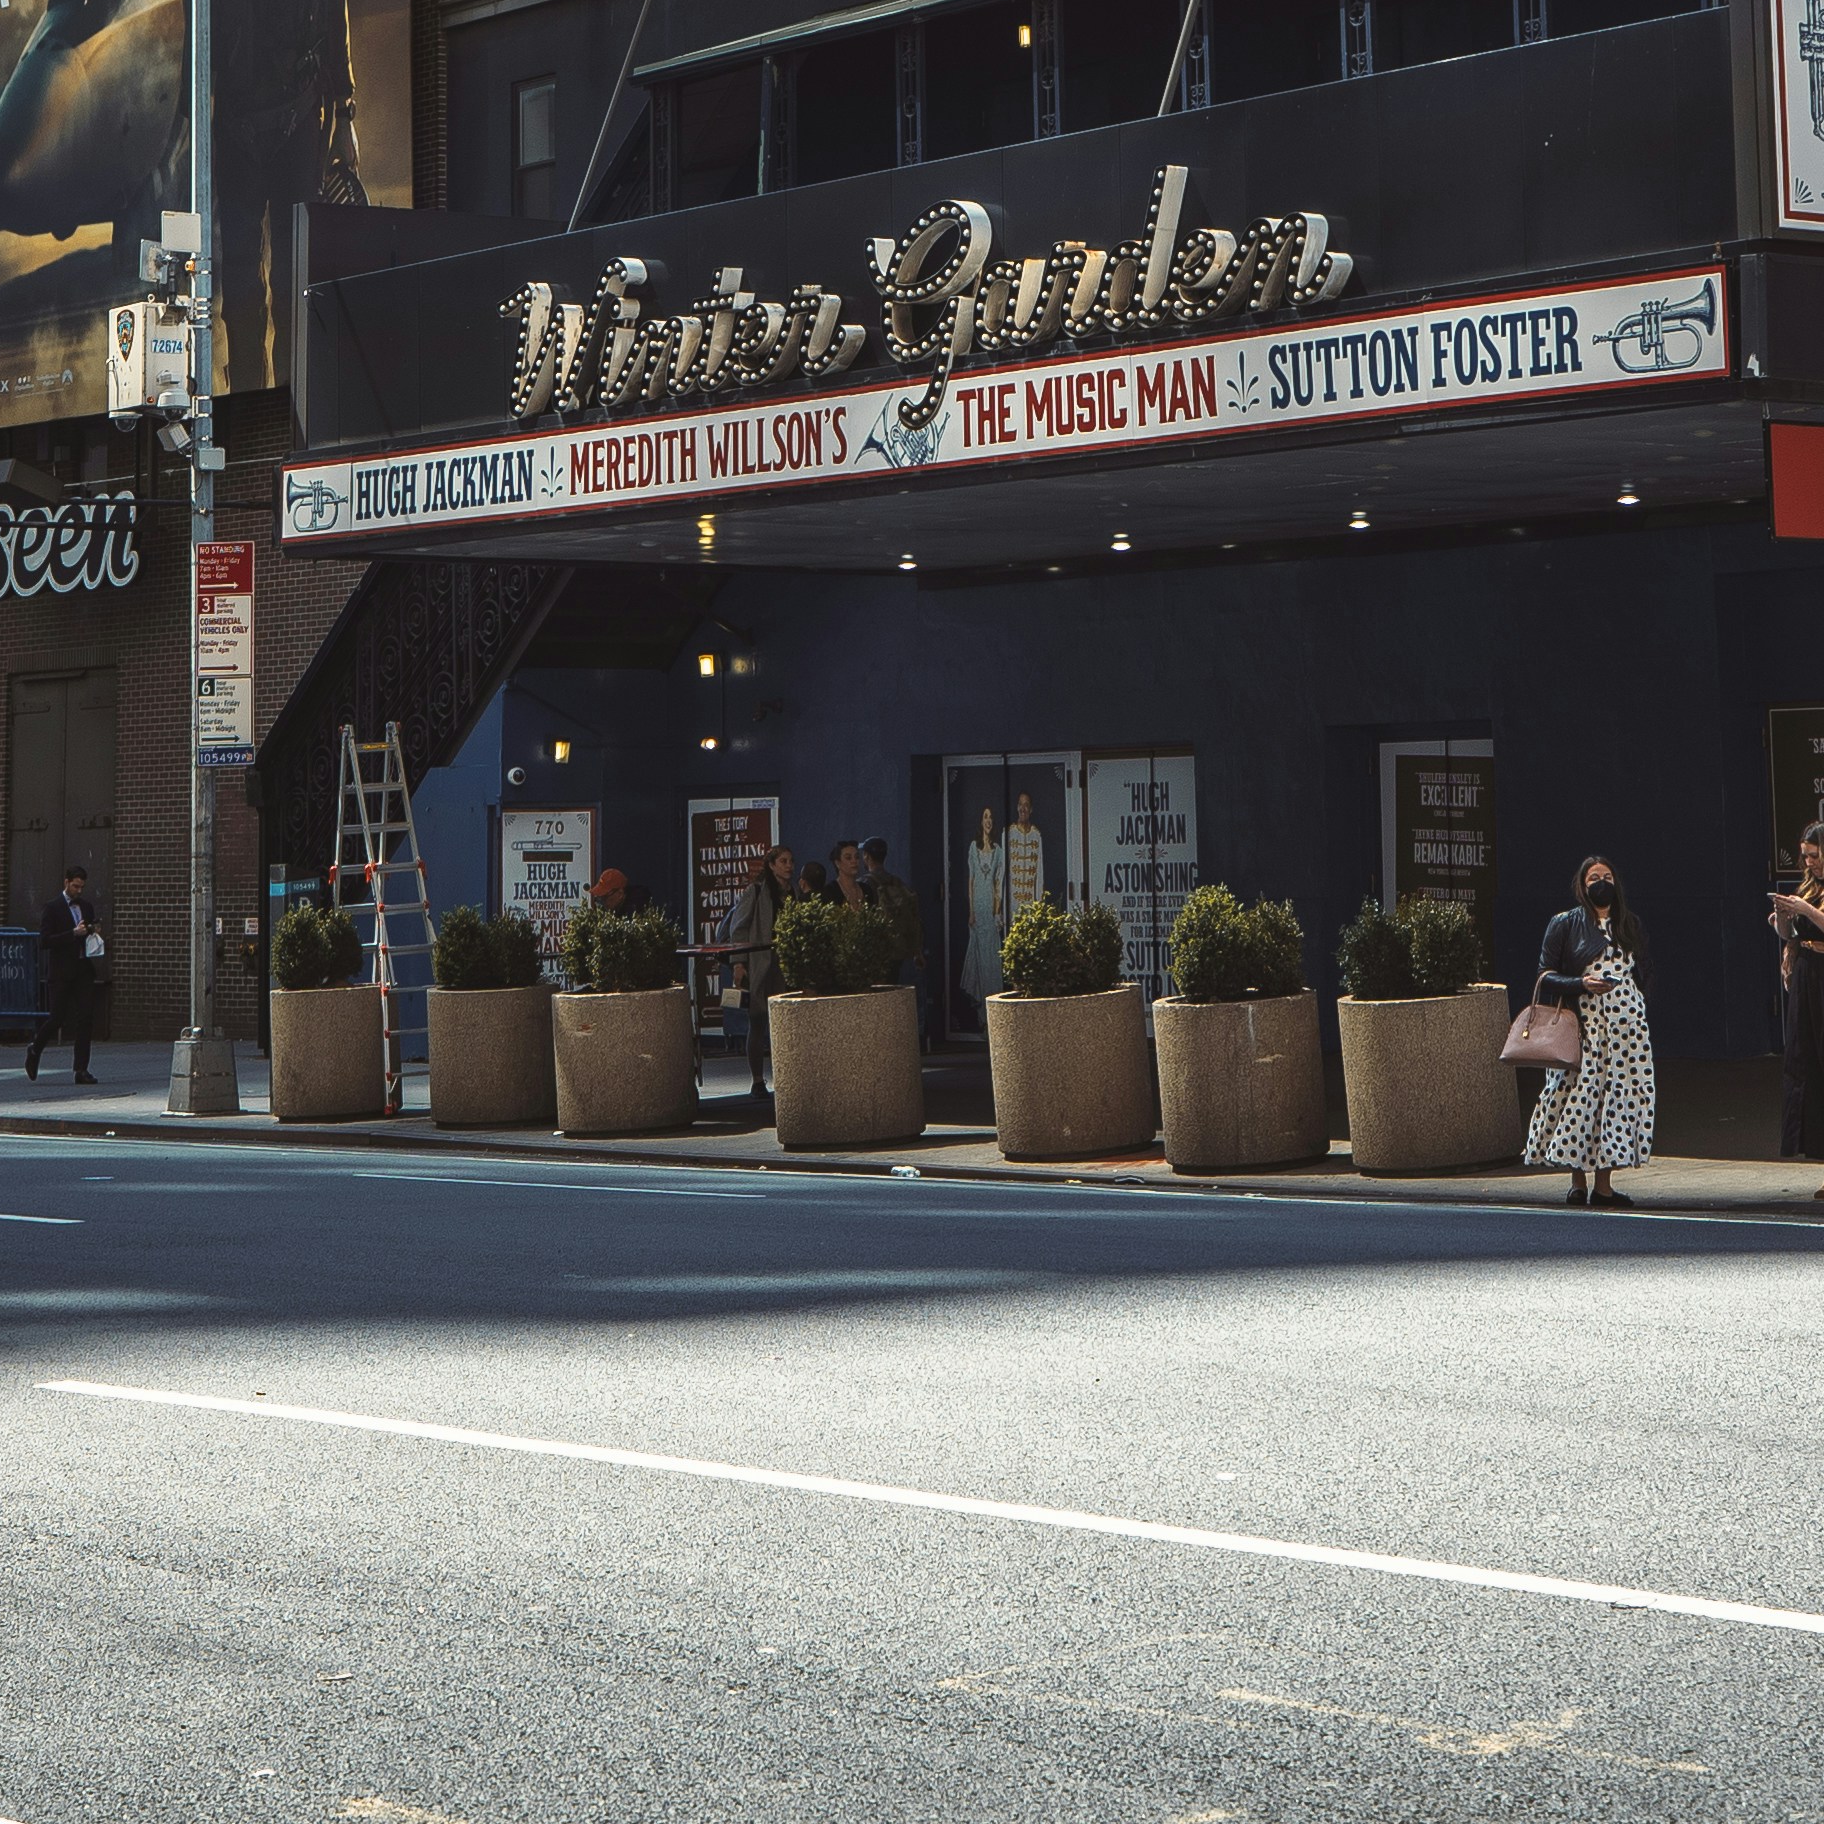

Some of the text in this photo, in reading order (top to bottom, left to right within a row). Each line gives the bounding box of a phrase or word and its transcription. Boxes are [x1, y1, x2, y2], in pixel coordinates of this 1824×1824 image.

[497, 165, 1354, 430] Winter Garden
[152, 340, 182, 353] 72674
[356, 305, 1582, 520] HUGH JACKMAN MEREDITH WILLSON'S THE MUSIC MAN SUTTON FOSTER
[202, 598, 210, 612] 3
[202, 680, 210, 694] 6
[201, 753, 239, 763] 105499
[535, 821, 564, 834] 770
[527, 863, 567, 881] HUGH
[514, 882, 580, 900] JACKMAN
[529, 901, 565, 910] MEREDITH
